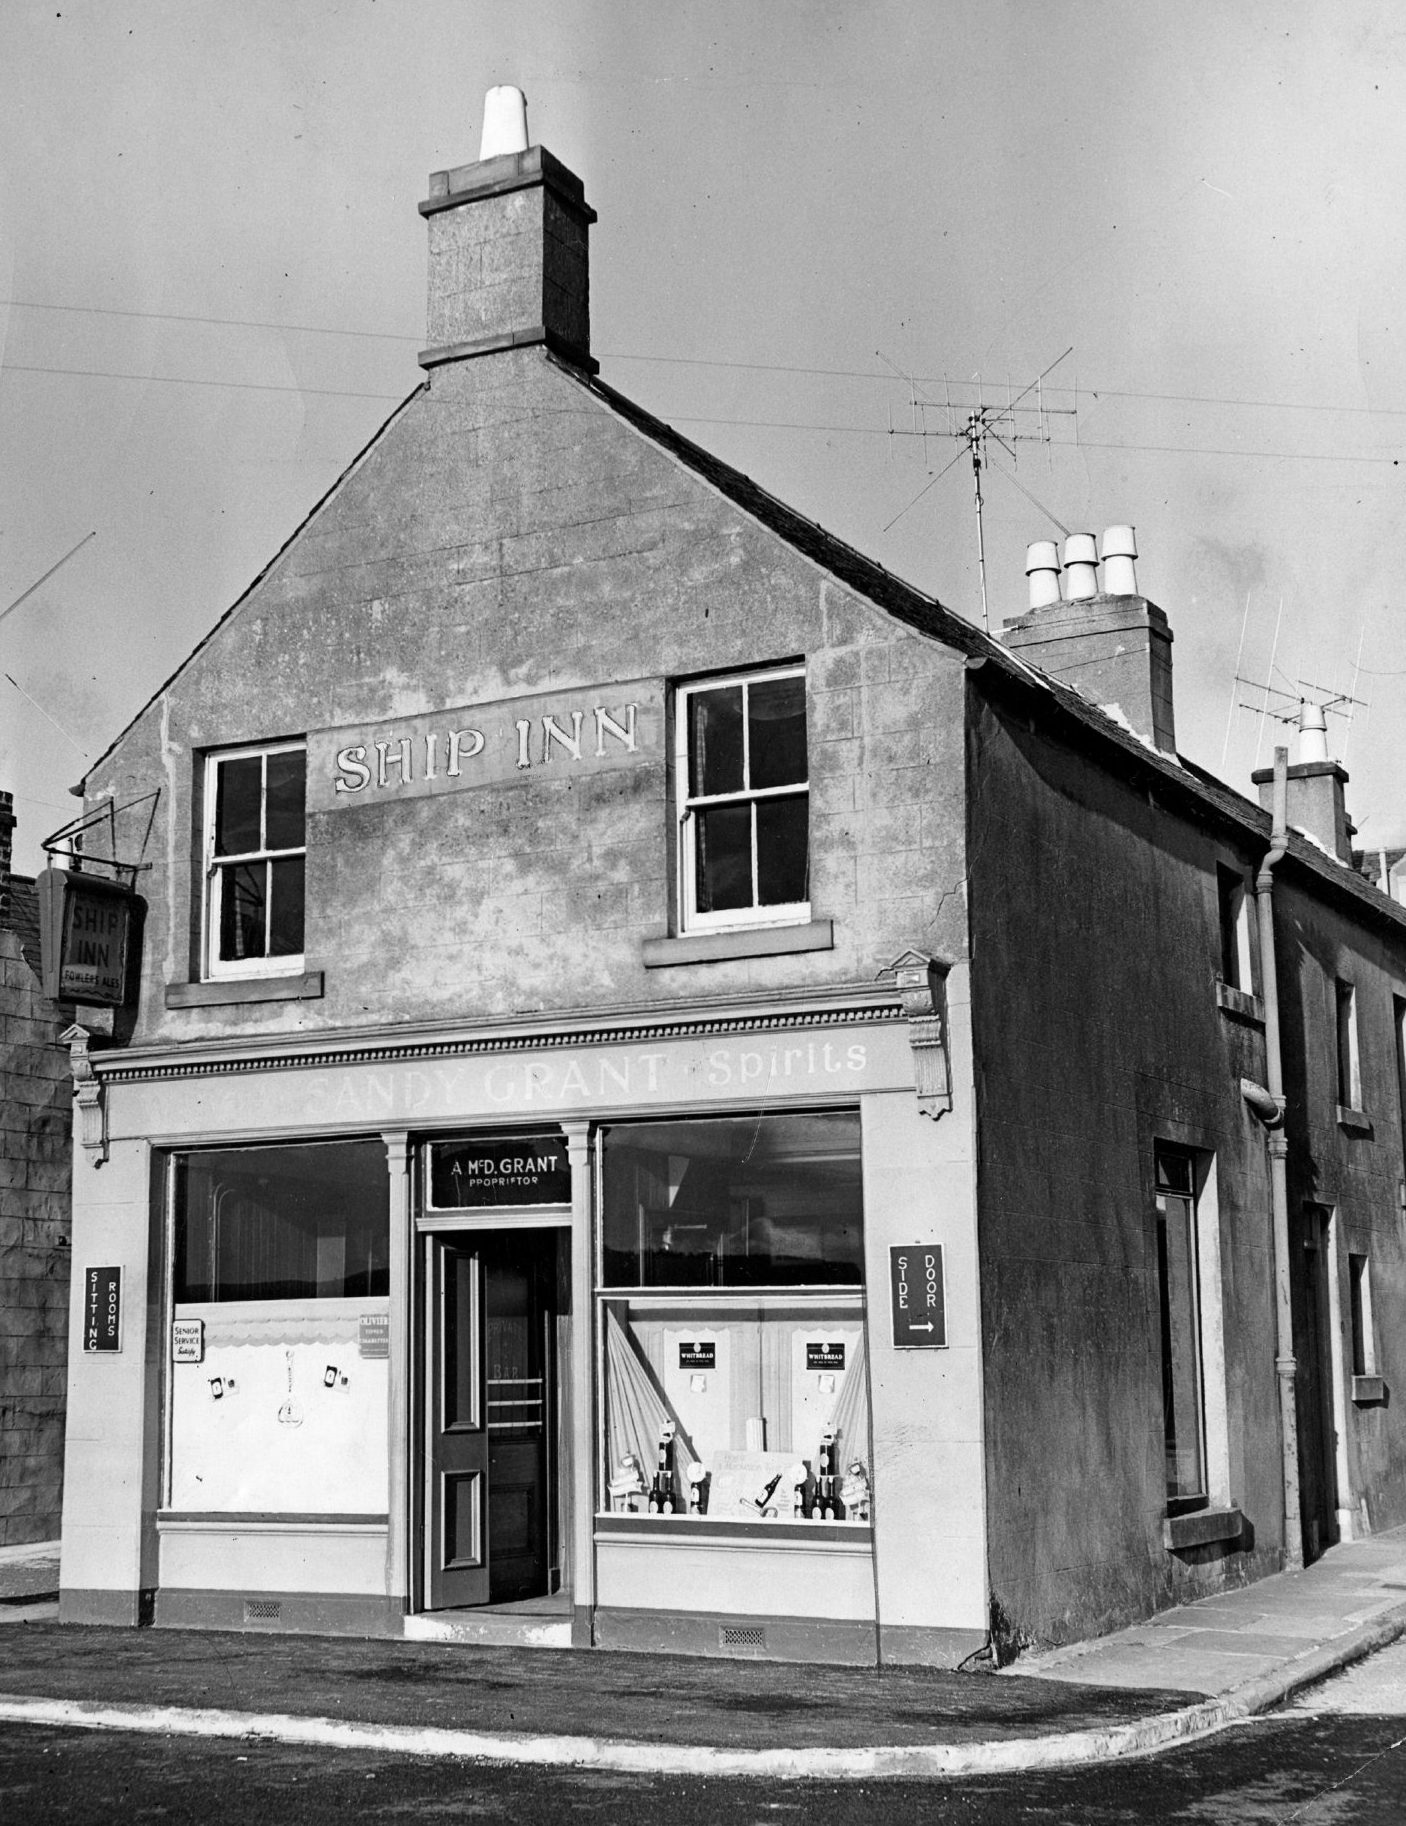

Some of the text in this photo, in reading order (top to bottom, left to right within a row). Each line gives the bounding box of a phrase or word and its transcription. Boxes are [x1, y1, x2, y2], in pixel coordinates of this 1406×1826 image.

[334, 703, 638, 796] SHIP INN
[73, 905, 118, 935] SHIP
[78, 940, 110, 968] INN
[102, 978, 120, 988] ALES
[305, 1067, 466, 1116] SANDY
[484, 1053, 668, 1101] GRANT
[708, 1043, 868, 1085] Spirits
[898, 1256, 908, 1308] SIDE
[925, 1255, 937, 1307] DOOR
[88, 1271, 99, 1351] SITTING
[107, 1281, 117, 1337] ROOMS
